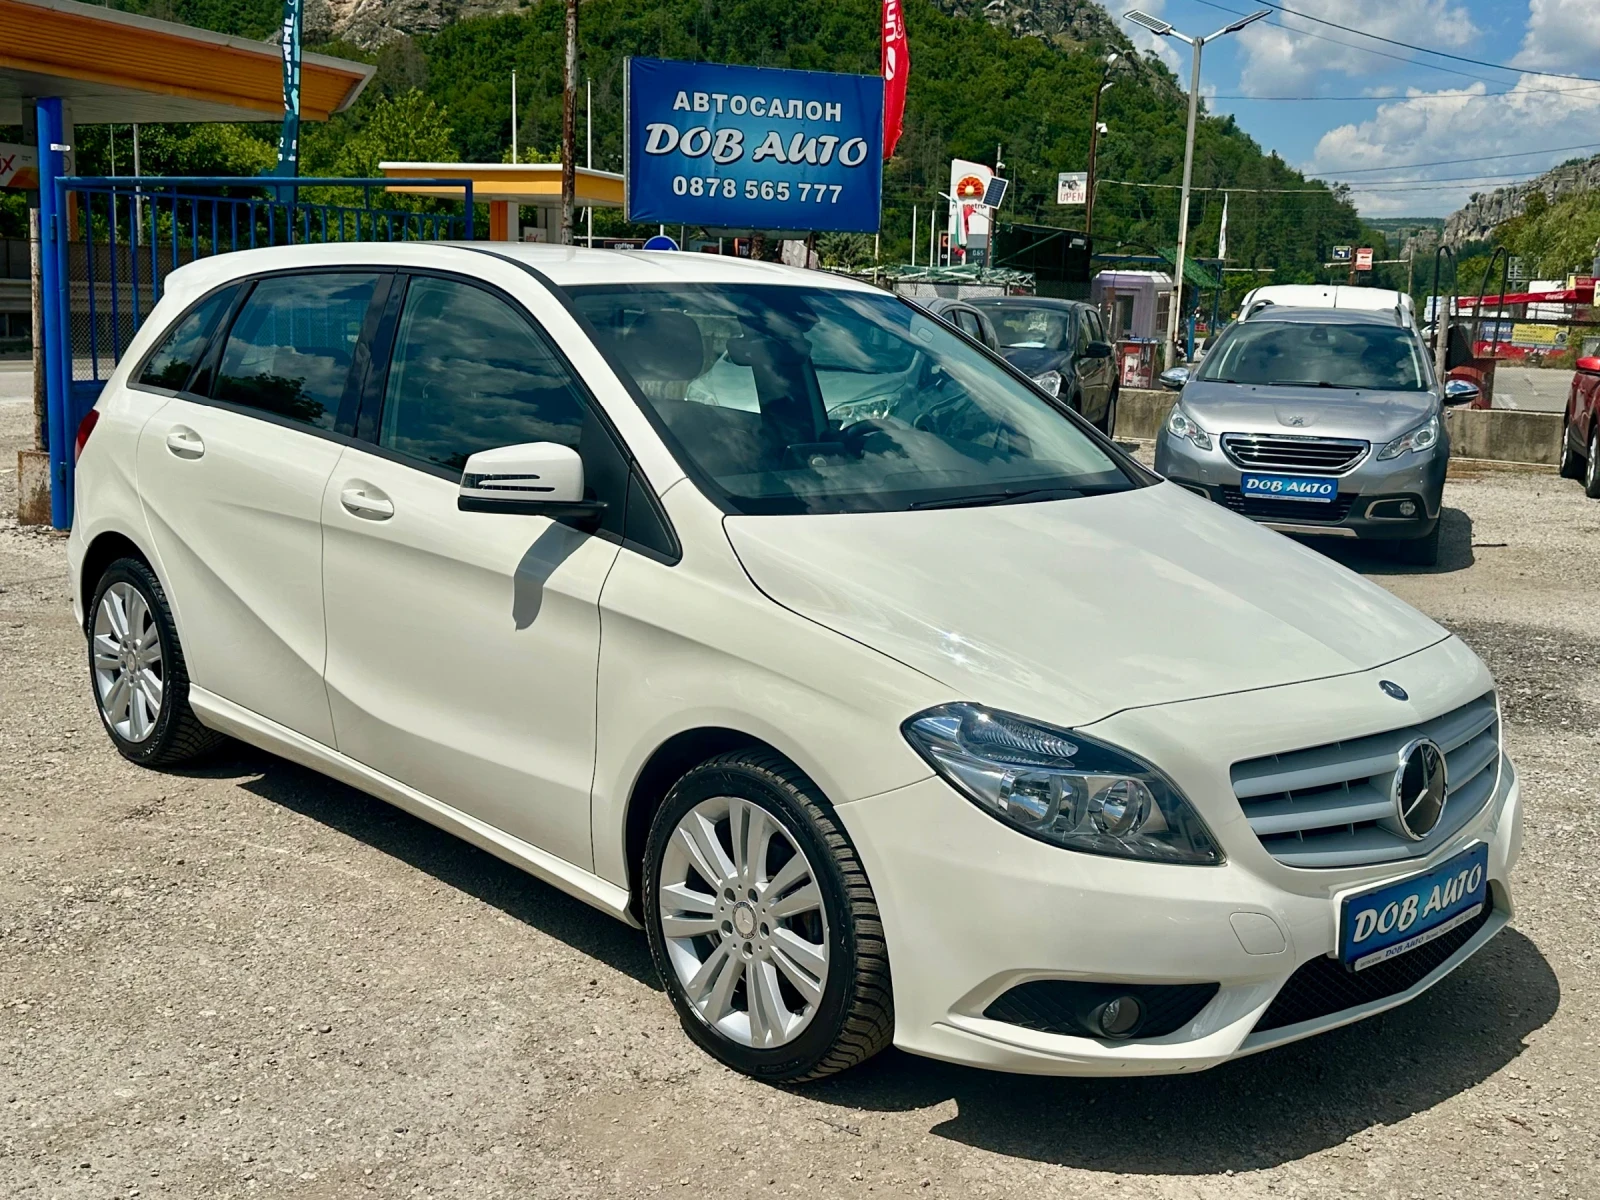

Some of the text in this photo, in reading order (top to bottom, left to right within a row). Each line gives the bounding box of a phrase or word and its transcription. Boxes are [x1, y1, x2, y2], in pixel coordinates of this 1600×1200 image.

[673, 91, 842, 122] АВТОСАЛОН
[645, 123, 868, 166] DOB AUTO
[672, 176, 843, 203] 0878 565 777
[1246, 478, 1332, 494] DOB AUTO
[1353, 863, 1482, 943] DOB AUTO
